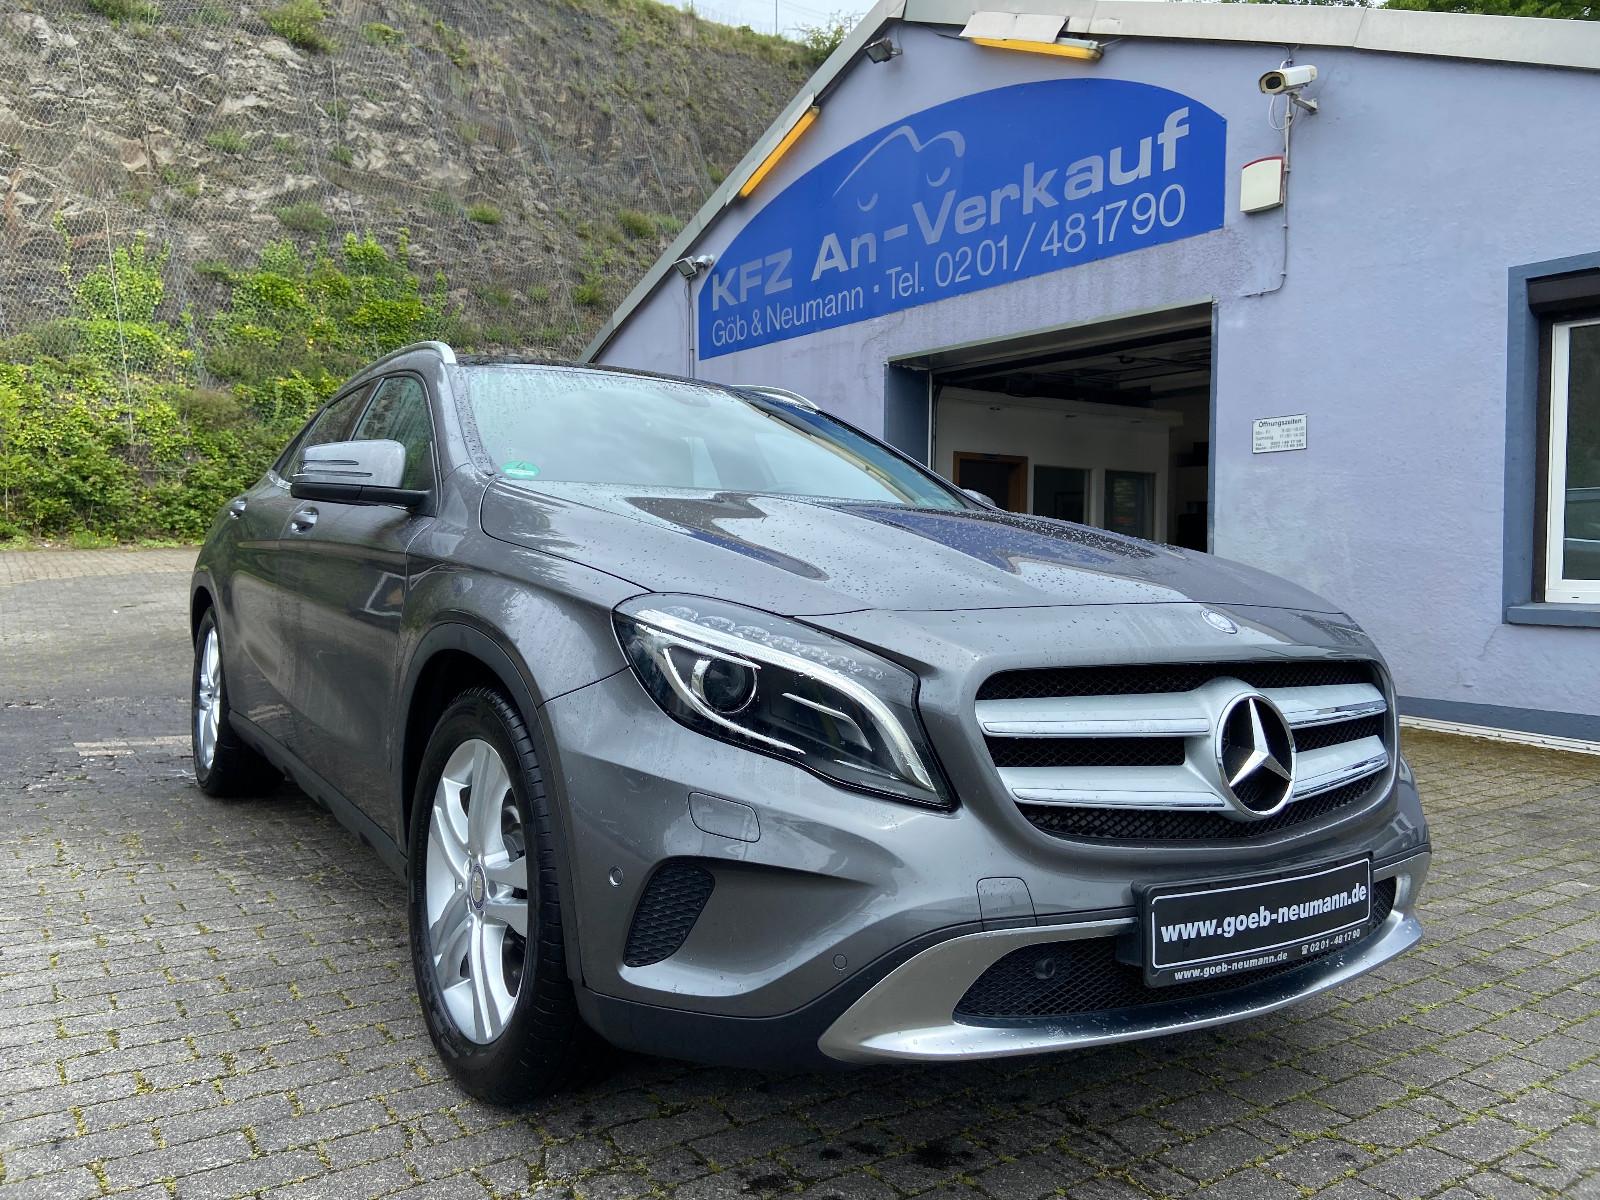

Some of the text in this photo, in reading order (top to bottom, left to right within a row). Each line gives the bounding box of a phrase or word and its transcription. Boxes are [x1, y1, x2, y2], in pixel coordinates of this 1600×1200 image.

[712, 106, 1190, 312] KFZ An-Verkauf
[712, 316, 748, 347] Göb
[751, 309, 763, 337] &
[766, 286, 864, 334] Neumann
[886, 261, 925, 300] Tel.
[1160, 882, 1367, 943] www.goeb-neumann.de
[1174, 951, 1289, 981] www.goeb-neumann.de
